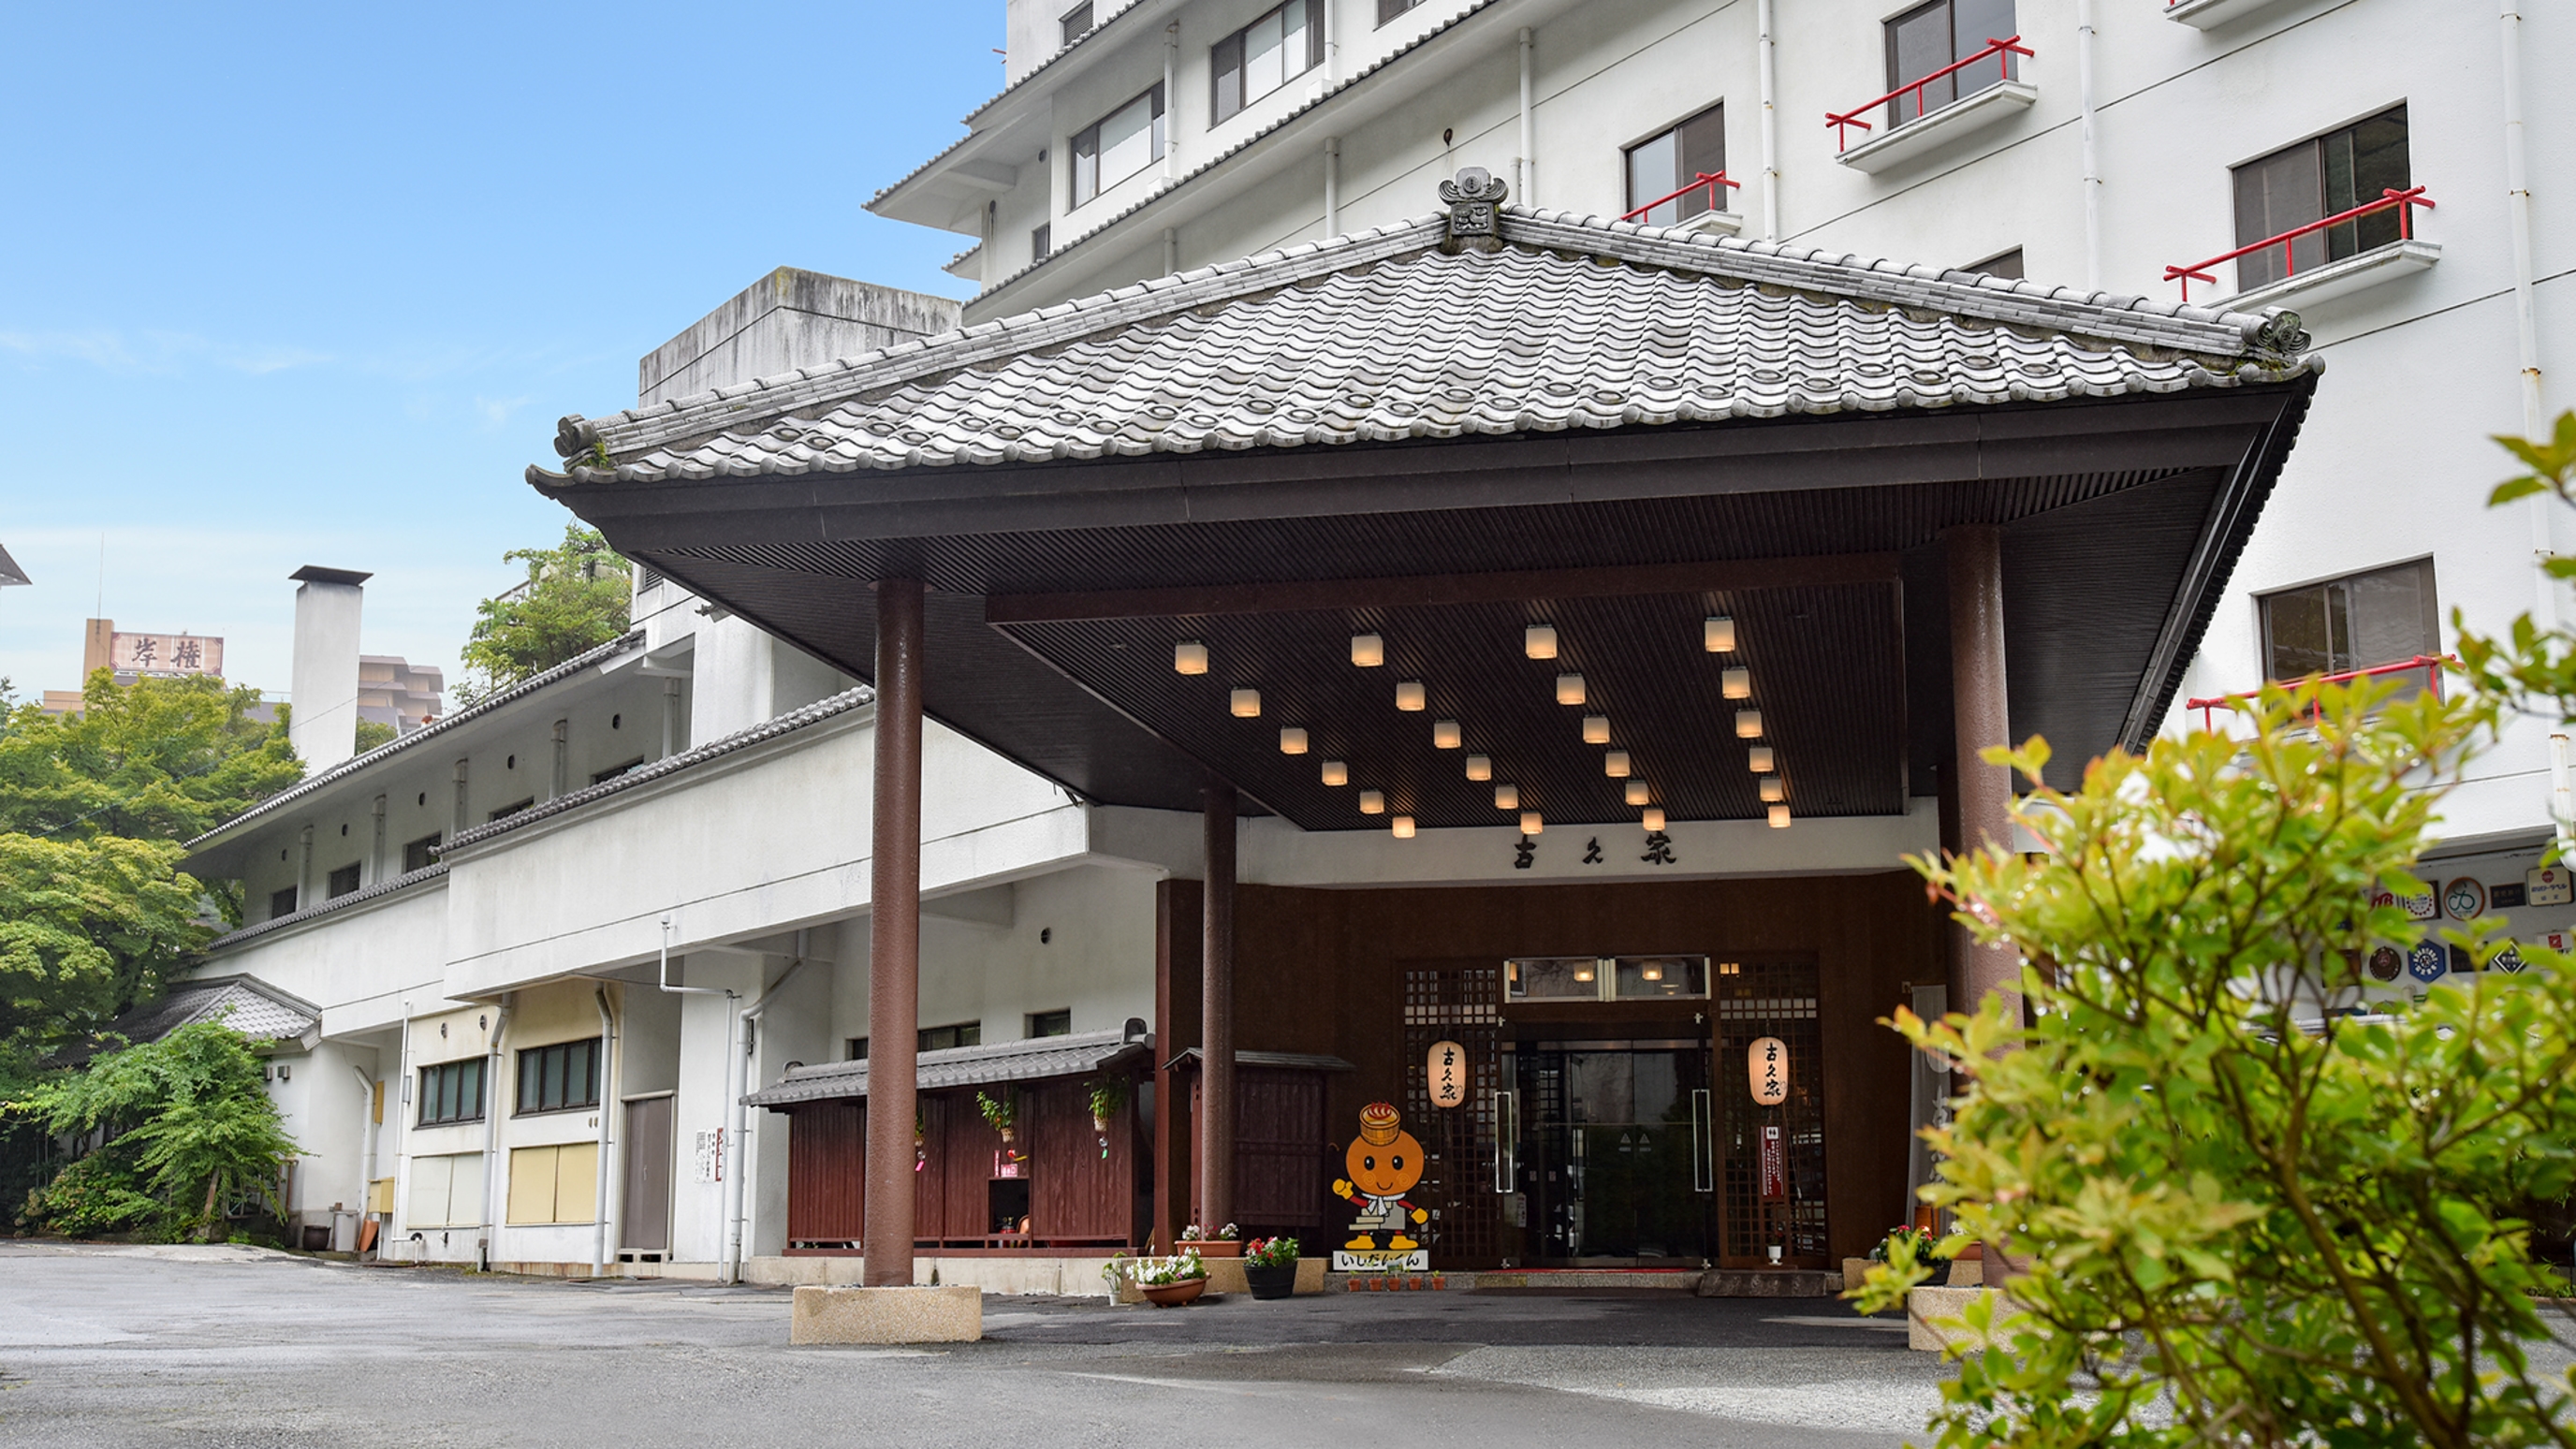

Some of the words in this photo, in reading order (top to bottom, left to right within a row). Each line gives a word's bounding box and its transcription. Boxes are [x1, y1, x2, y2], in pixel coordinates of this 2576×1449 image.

[131, 637, 200, 669] 岸権
[1514, 830, 1676, 869] 古久家
[1440, 1046, 1457, 1100] 古久家
[1763, 1041, 1781, 1096] 古久家
